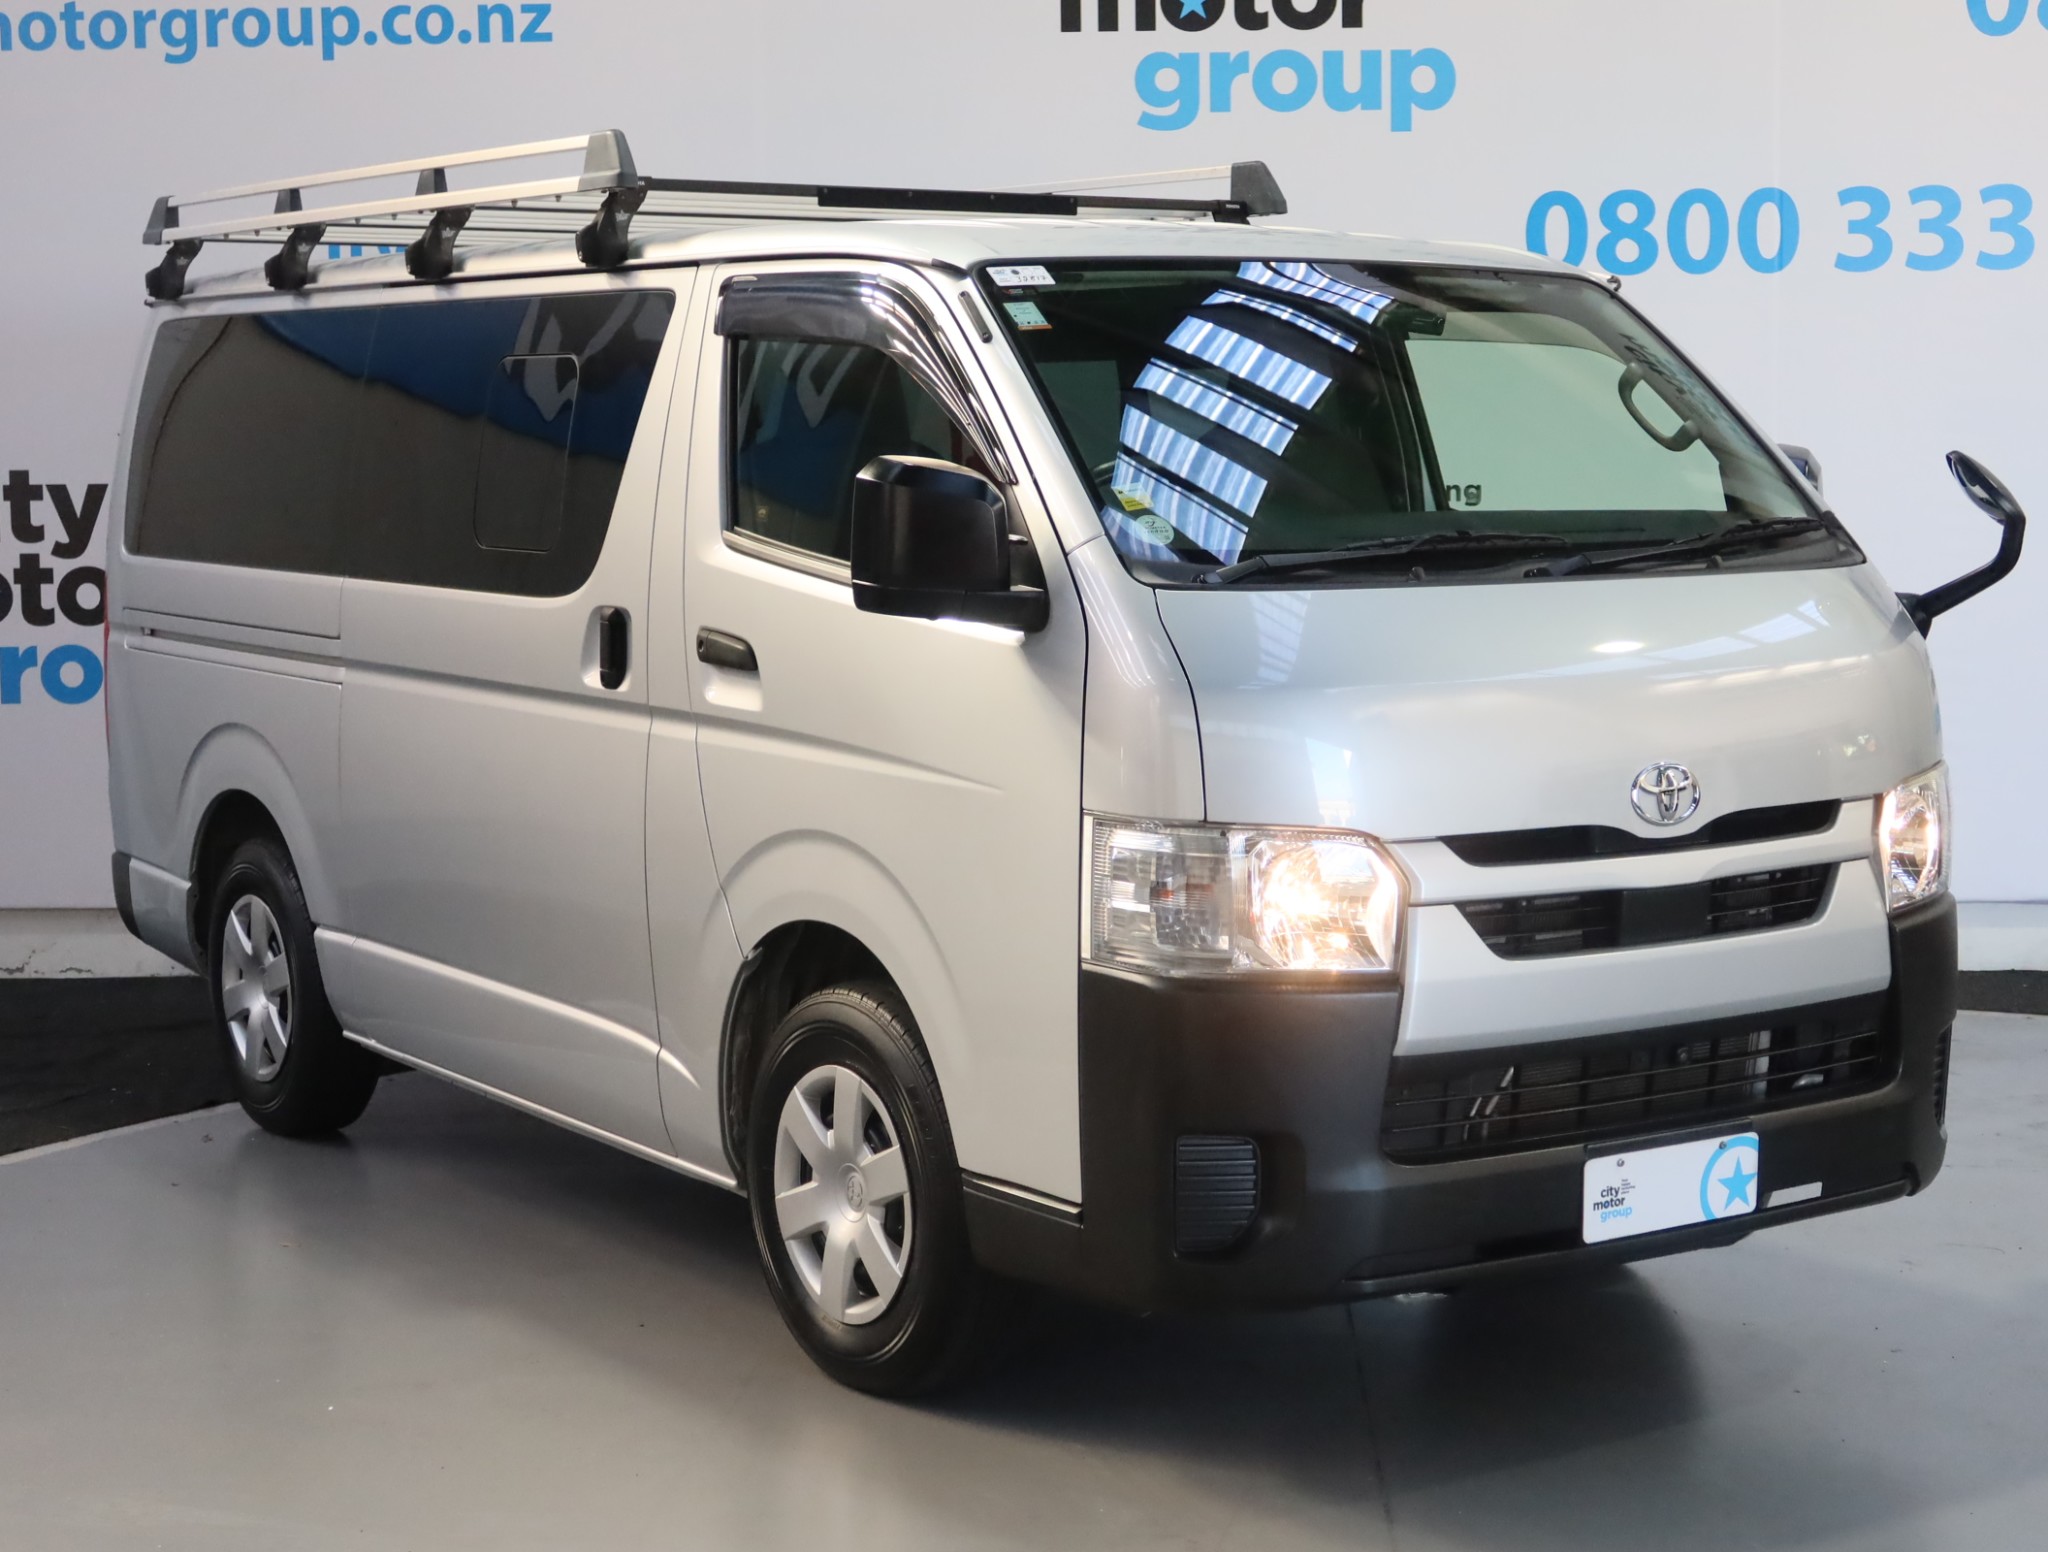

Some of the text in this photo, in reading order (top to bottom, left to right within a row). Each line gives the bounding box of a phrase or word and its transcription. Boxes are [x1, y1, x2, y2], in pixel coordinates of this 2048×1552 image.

[1134, 47, 1457, 132] group
[1526, 183, 2036, 275] 0800 333
[0, 470, 109, 559] ty
[0, 553, 107, 627] to
[1593, 1197, 1625, 1212] motor
[1600, 1185, 1620, 1198] city
[1600, 1206, 1632, 1223] group
